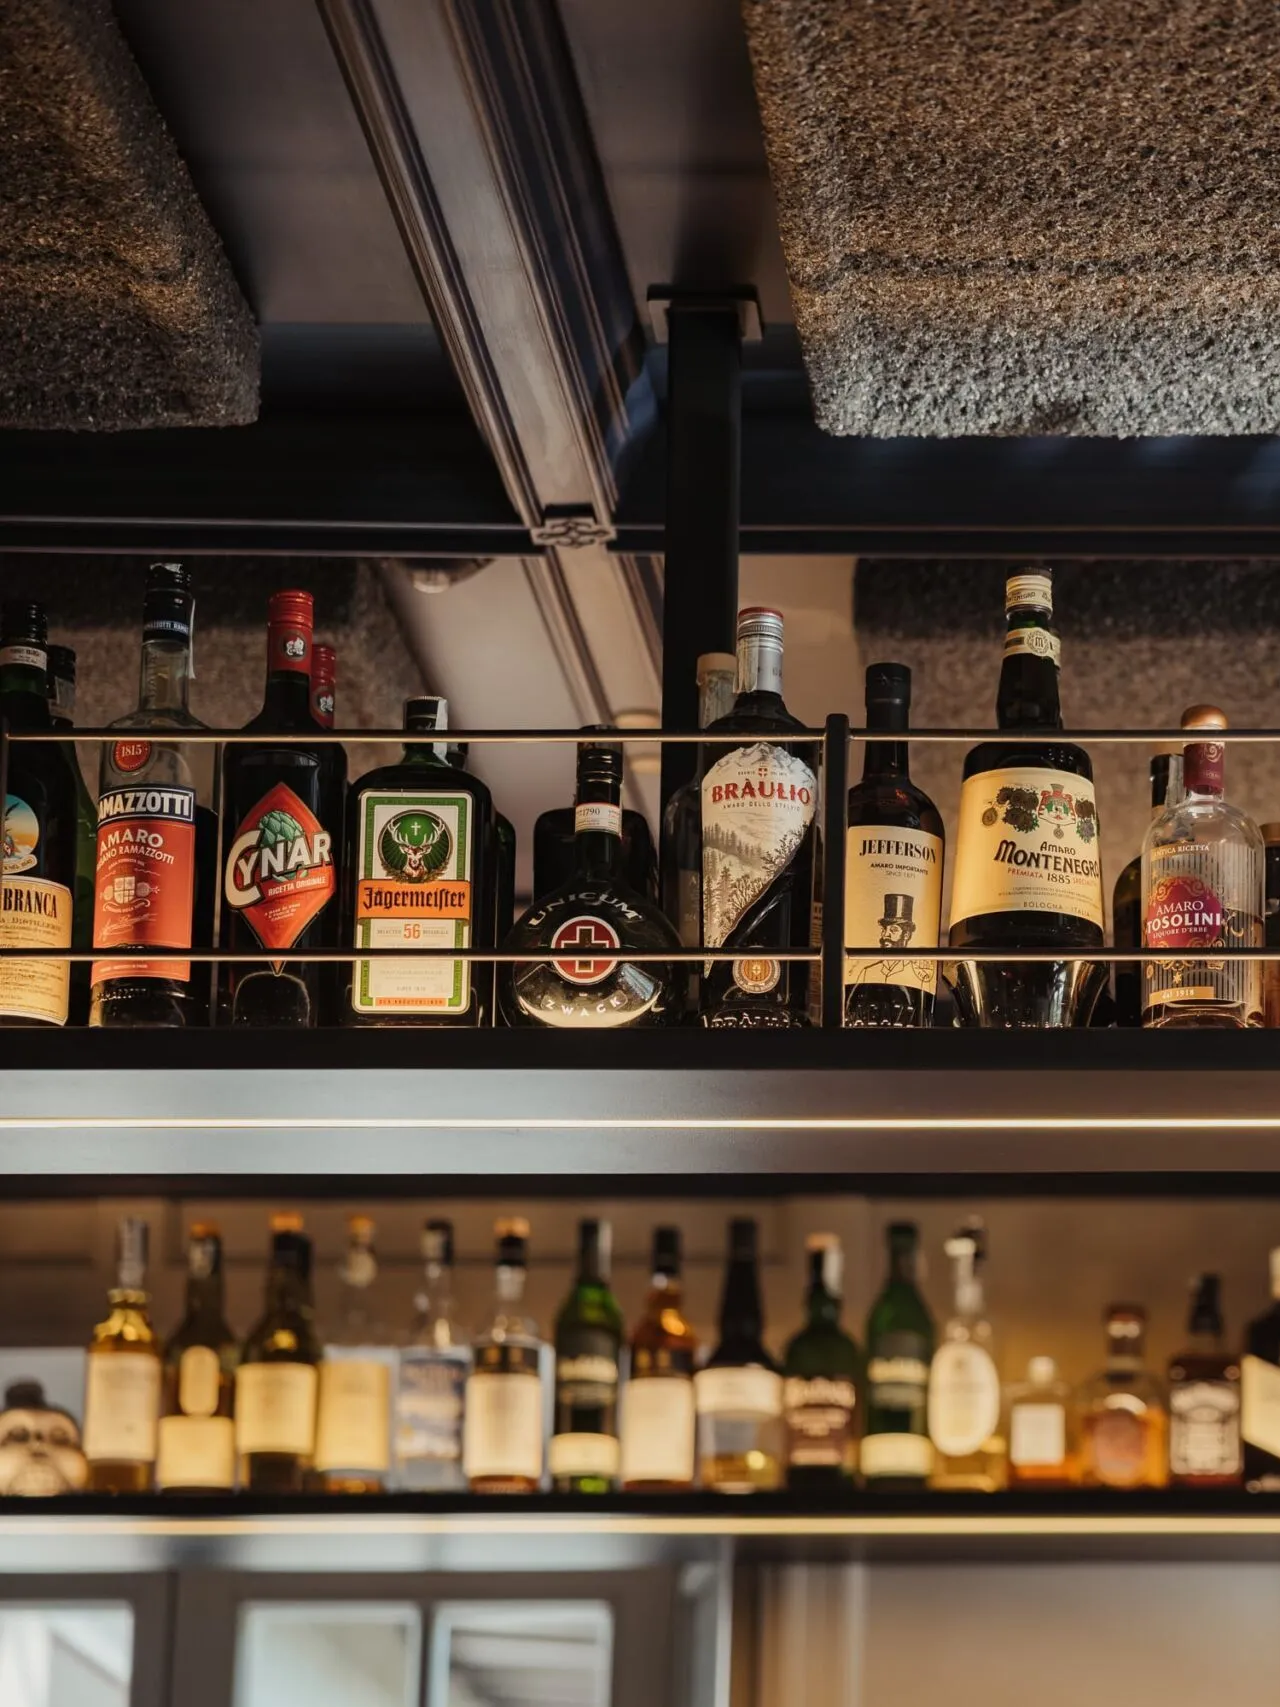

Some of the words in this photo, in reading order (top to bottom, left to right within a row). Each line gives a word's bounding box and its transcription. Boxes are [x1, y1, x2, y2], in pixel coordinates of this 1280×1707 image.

[121, 744, 142, 758] 1815
[100, 827, 164, 858] AMARO
[858, 839, 937, 864] JEFFERSON
[1177, 844, 1211, 853] RICETTA
[118, 845, 175, 865] RAMAZZOTTI
[1007, 867, 1044, 879] PREMIATA
[1047, 872, 1071, 885] 1885
[268, 882, 295, 897] RICETTA
[3, 887, 58, 919] BRANCA
[528, 892, 643, 926] UNICUM
[1023, 901, 1063, 910] BOLOGNA
[1156, 900, 1204, 917] AMARO
[403, 923, 422, 940] 56
[1146, 912, 1221, 934] TOSOLINI
[545, 996, 622, 1017] ZWACK
